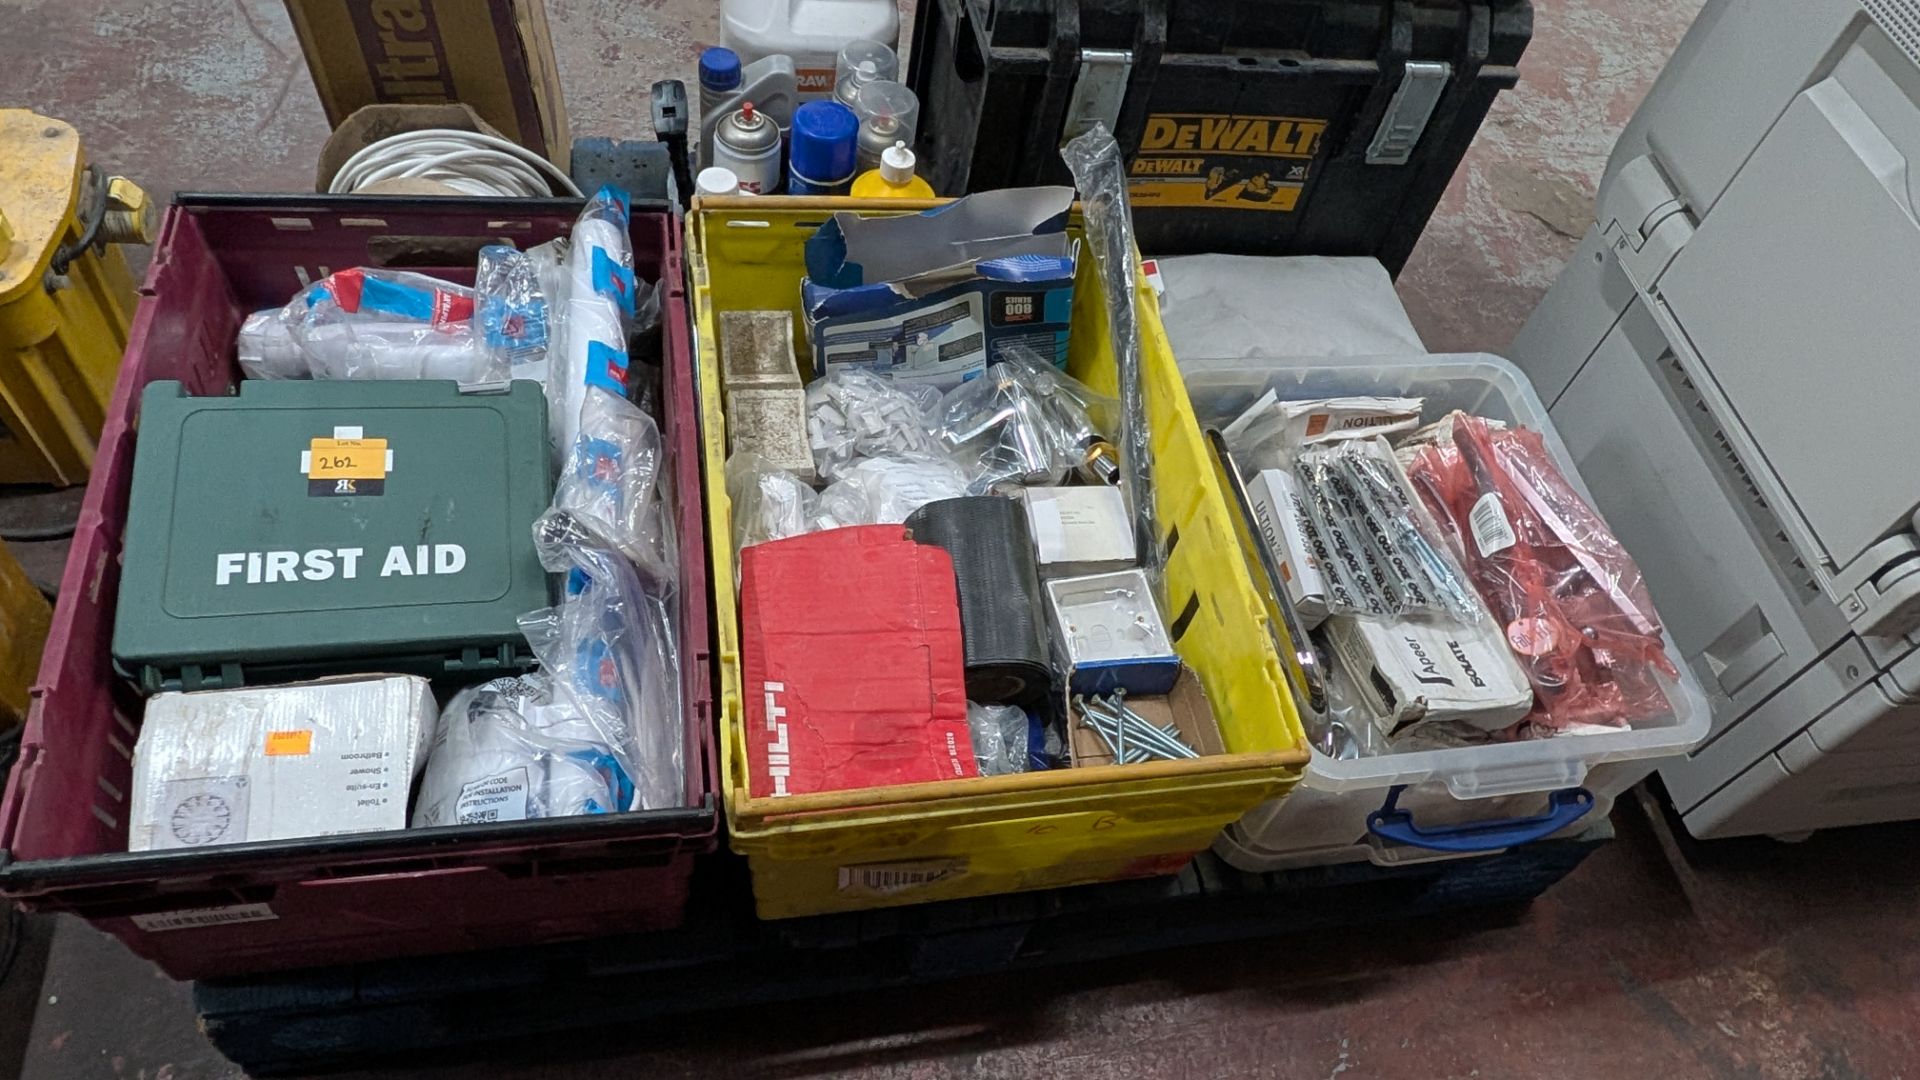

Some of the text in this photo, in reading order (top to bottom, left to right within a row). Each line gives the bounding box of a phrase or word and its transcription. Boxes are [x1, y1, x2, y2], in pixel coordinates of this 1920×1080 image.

[1005, 304, 1033, 316] 800
[319, 456, 358, 470] 262
[1256, 501, 1278, 548] ULTION
[216, 544, 467, 585] FIRST AID
[1404, 636, 1441, 675] Apeer
[1446, 640, 1487, 688] ISOLATE
[764, 681, 792, 797] HILTI
[341, 751, 383, 760] Bathroom
[350, 767, 382, 775] Shower
[346, 782, 381, 791] En-suite
[489, 776, 508, 786] CODE
[357, 799, 381, 807] Toilet
[460, 796, 509, 809] INSTRUCTIONS
